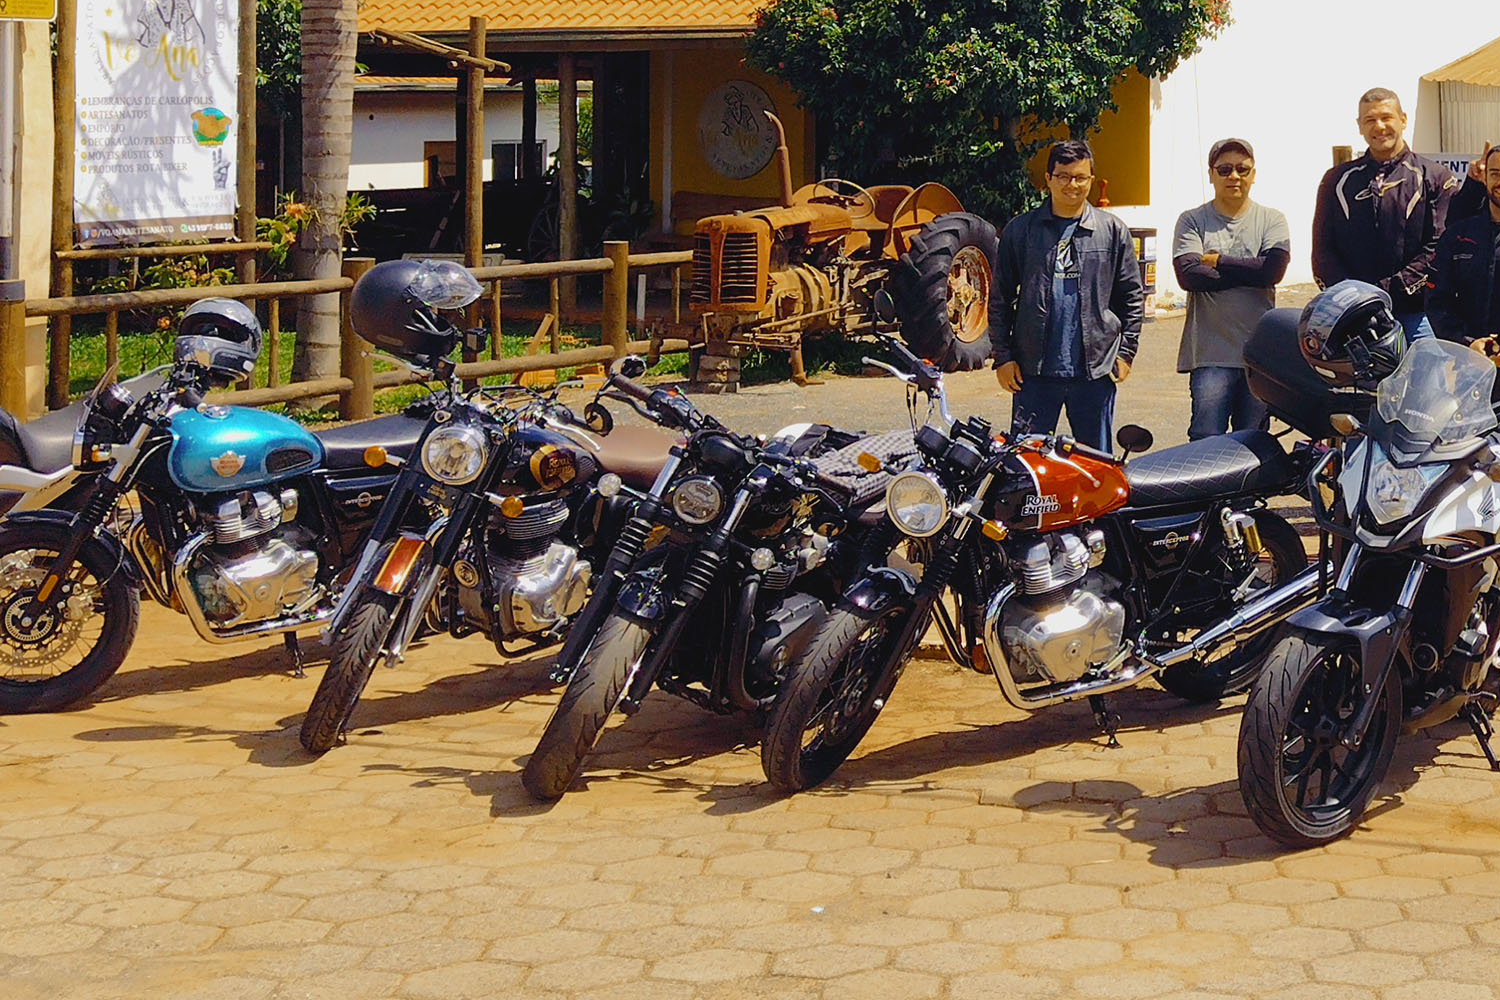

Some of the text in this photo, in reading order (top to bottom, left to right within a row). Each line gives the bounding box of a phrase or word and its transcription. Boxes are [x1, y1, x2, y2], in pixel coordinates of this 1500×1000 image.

[145, 32, 201, 81] Ana
[145, 96, 156, 105] DE
[88, 110, 149, 120] ARTESANATOS
[88, 163, 134, 174] PRODUTOS
[1404, 408, 1434, 422] HONDA
[1026, 494, 1058, 505] ROYAL
[1021, 503, 1061, 516] ENFIELD
